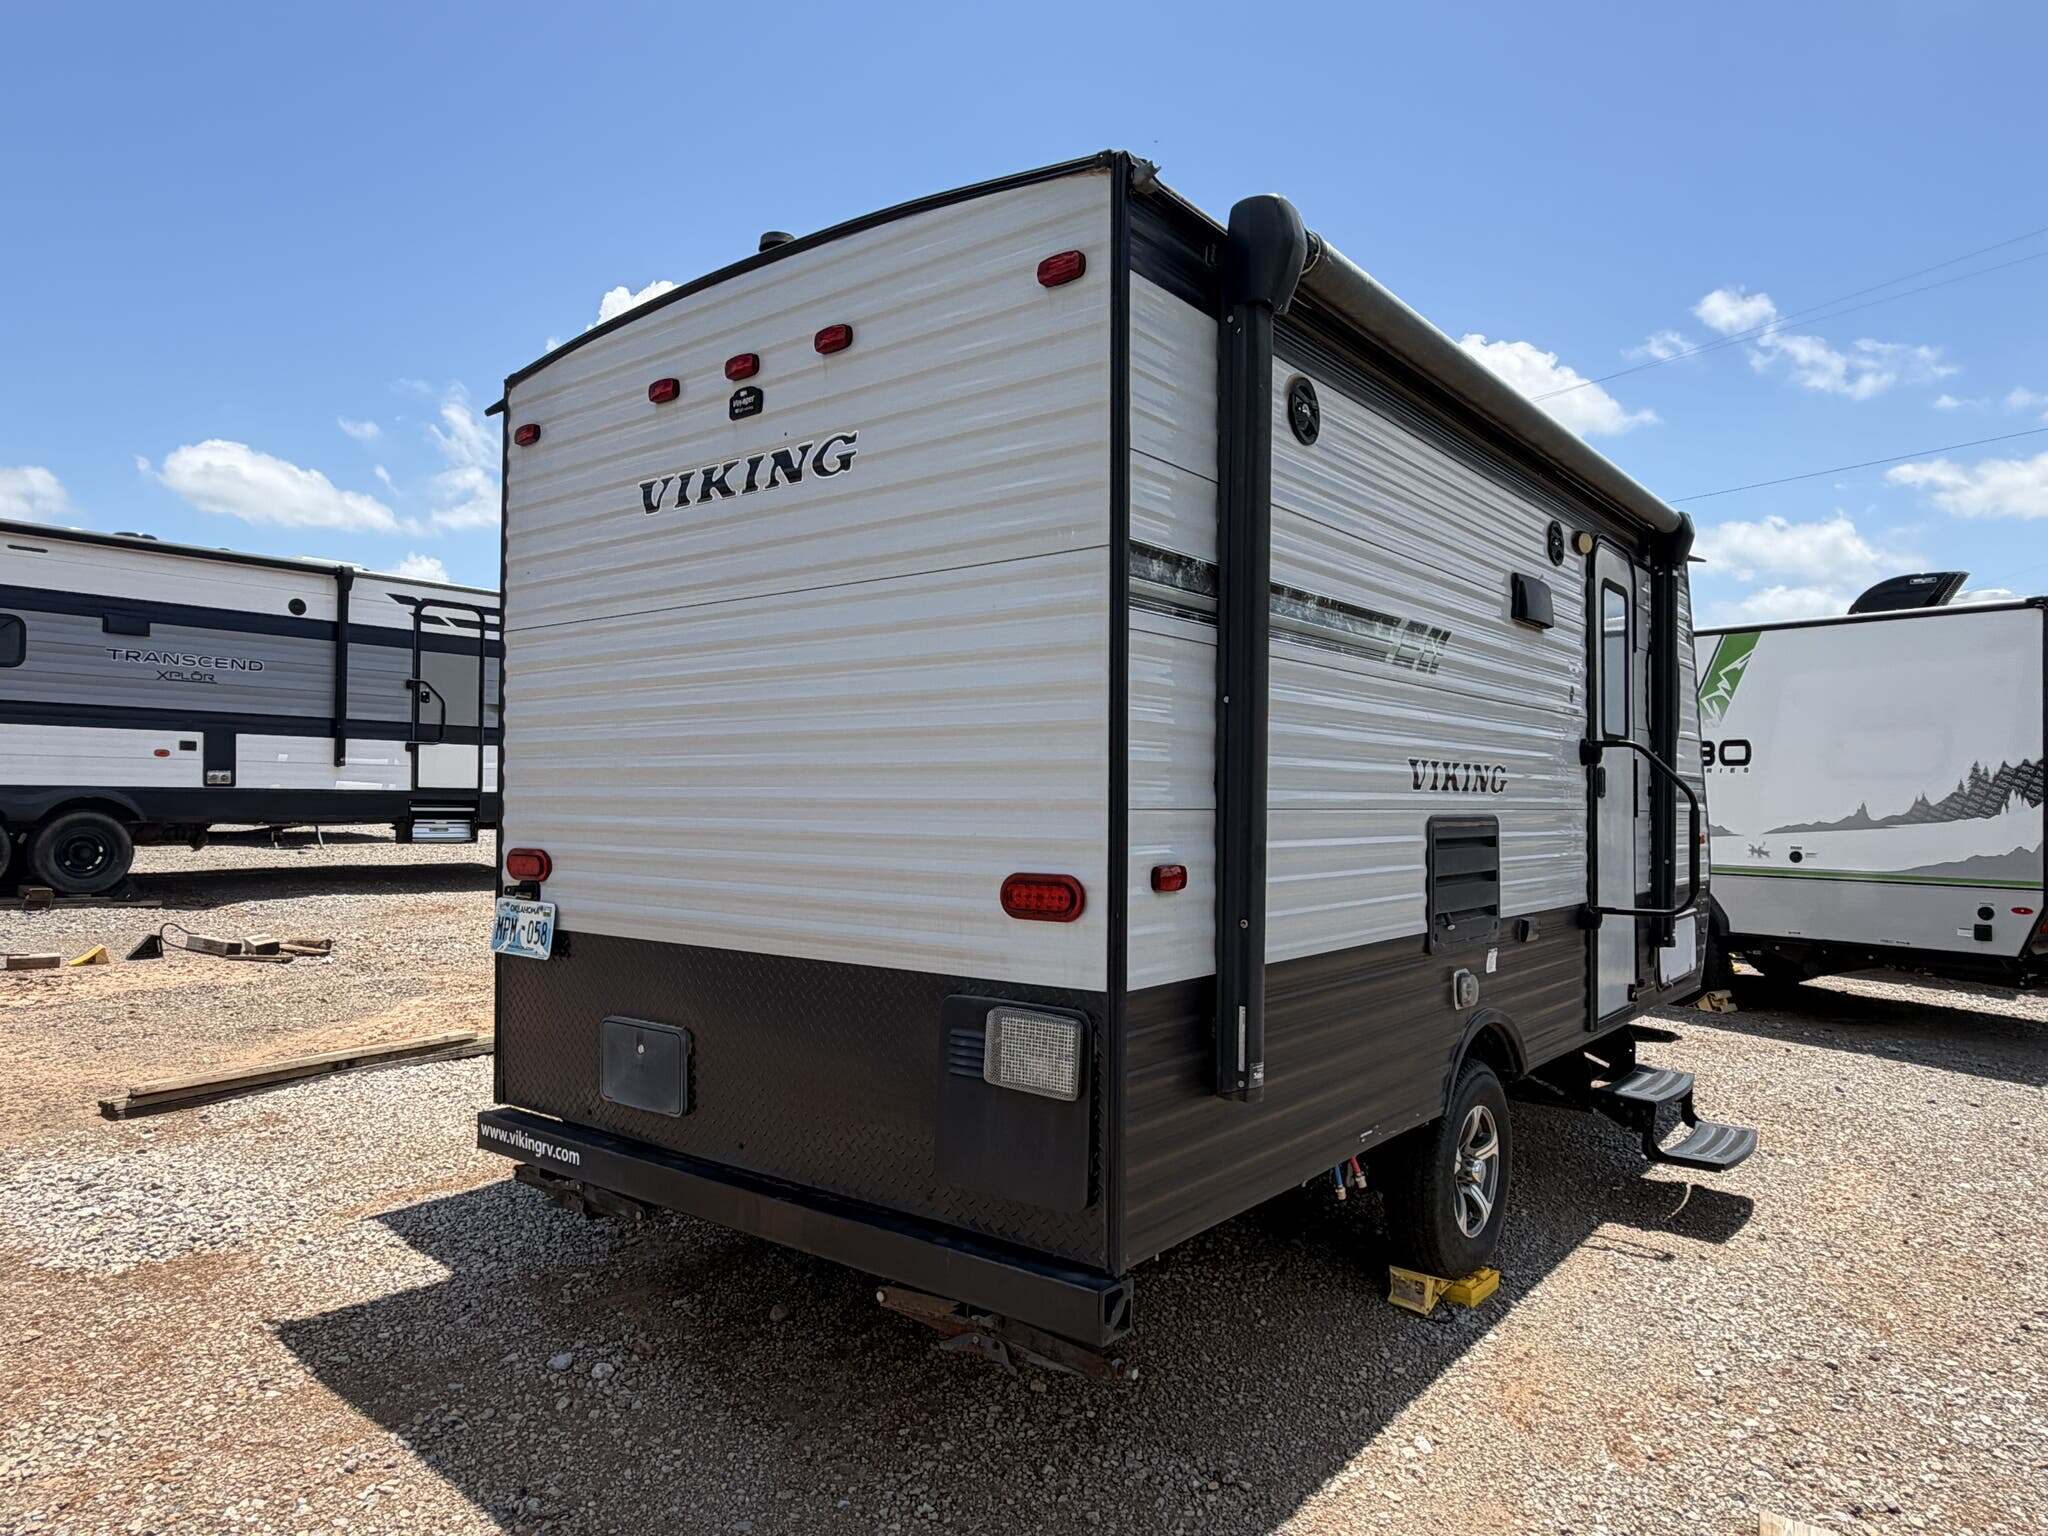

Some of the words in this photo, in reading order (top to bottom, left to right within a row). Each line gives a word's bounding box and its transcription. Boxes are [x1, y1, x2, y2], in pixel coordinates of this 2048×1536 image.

[639, 431, 859, 515] VIKING
[106, 648, 265, 672] TRANSCEND
[1408, 758, 1508, 794] VIKING
[480, 1123, 580, 1166] www.vikingrv.com
